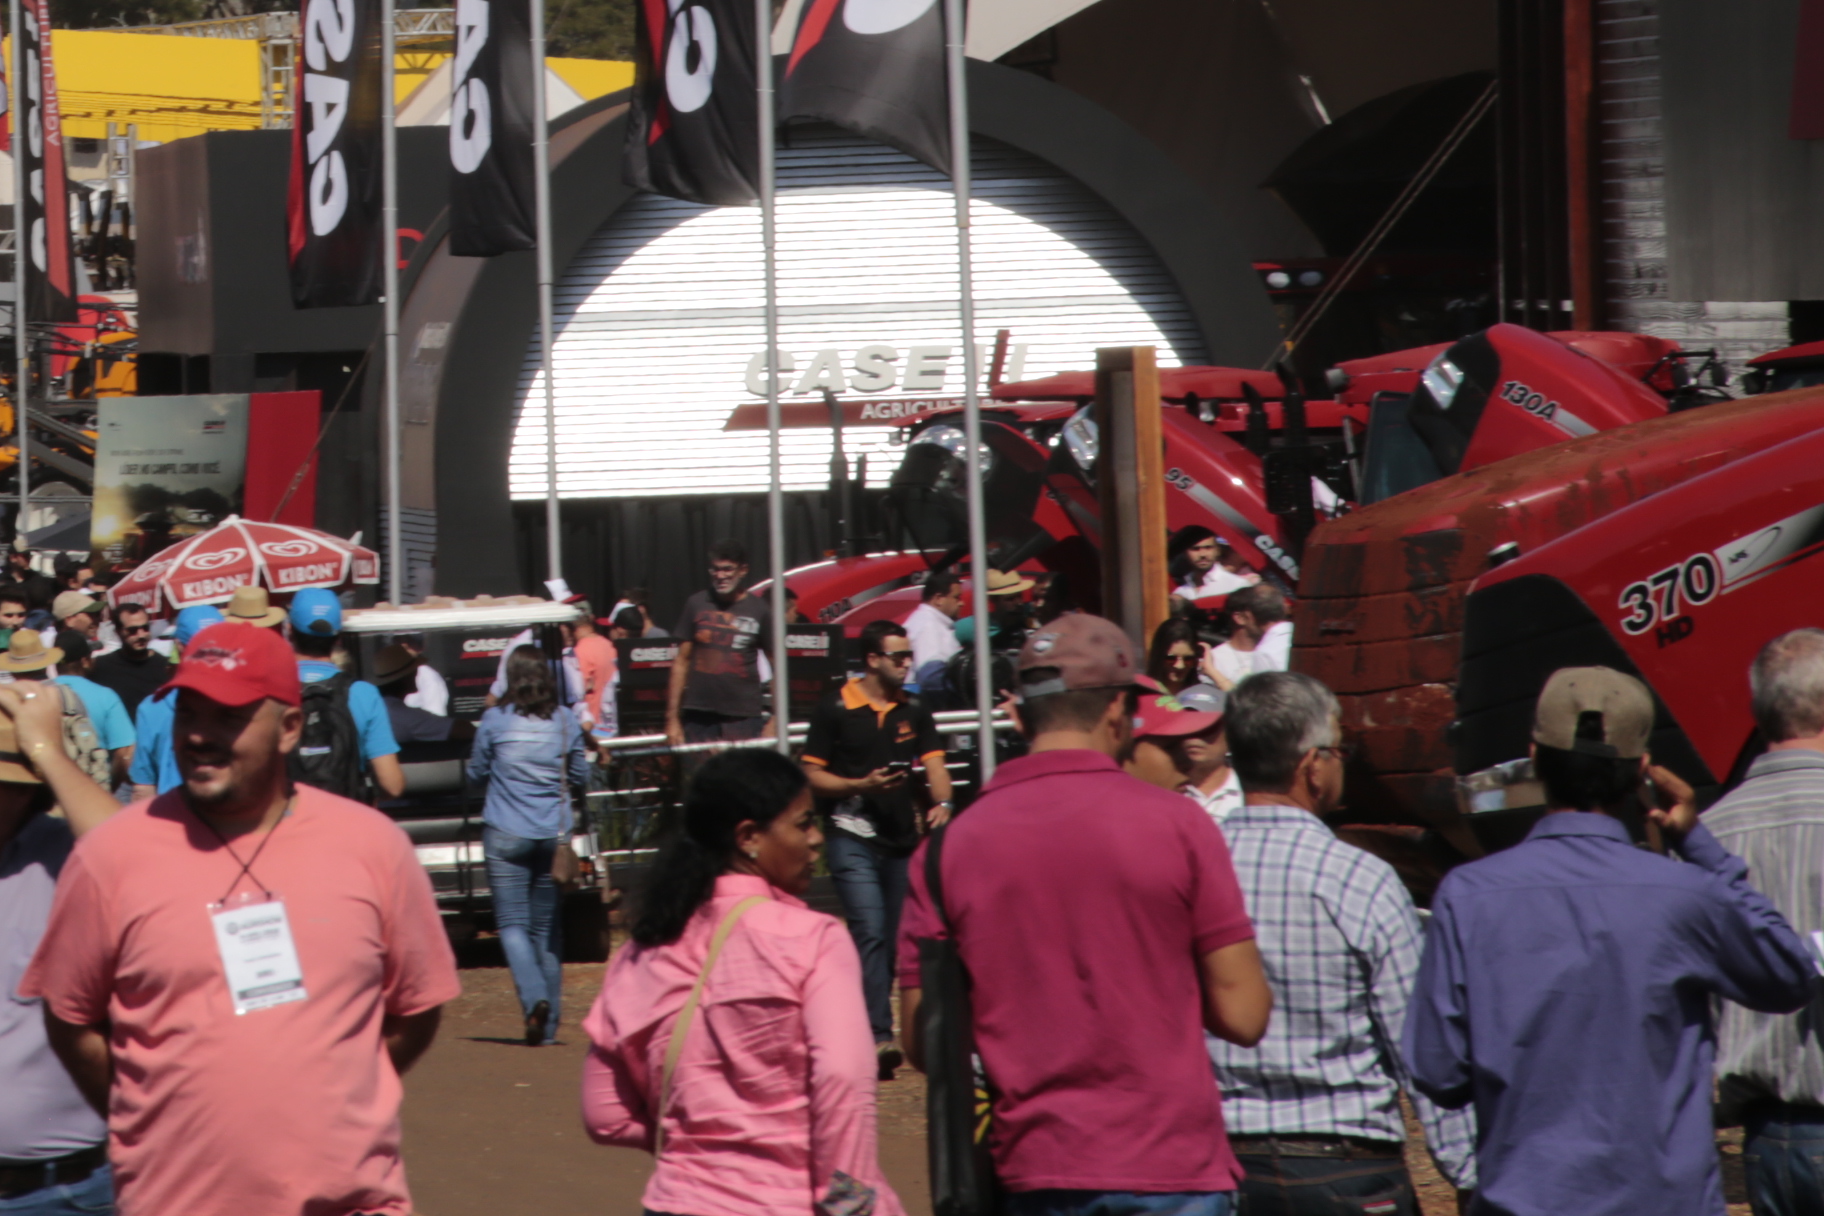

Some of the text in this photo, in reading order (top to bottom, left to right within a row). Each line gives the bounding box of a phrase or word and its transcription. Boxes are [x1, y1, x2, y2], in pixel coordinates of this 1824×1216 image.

[743, 344, 954, 396] CASE
[1499, 380, 1561, 423] 130A
[182, 576, 244, 600] KIBON
[278, 565, 333, 585] KIBON
[1618, 552, 1721, 636] 370
[462, 638, 508, 653] CASE
[1653, 615, 1695, 650] HD
[630, 647, 667, 662] CASE
